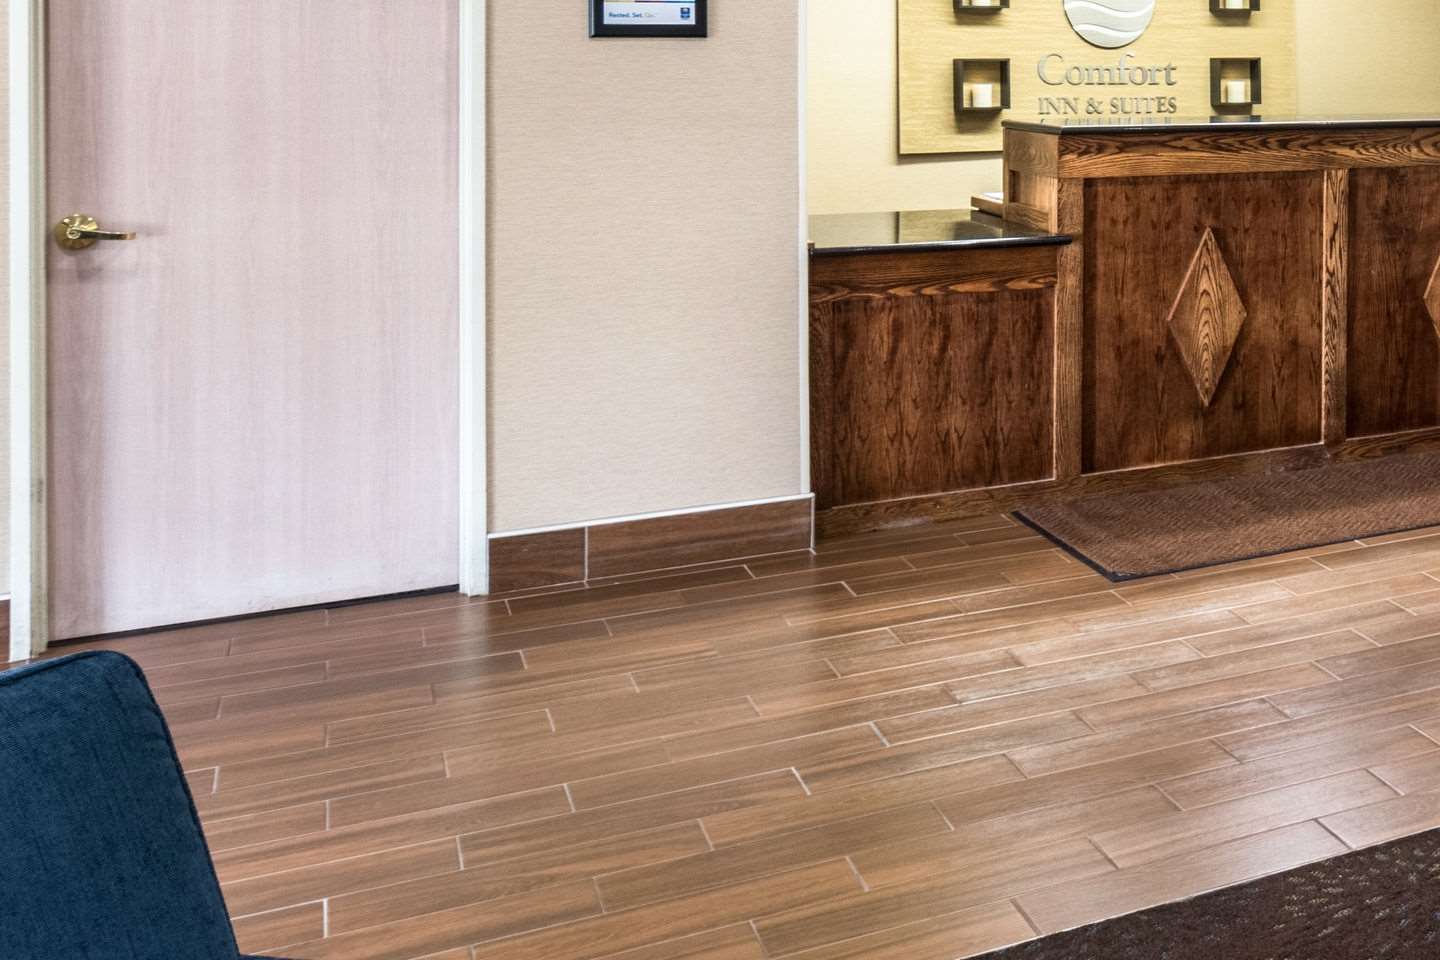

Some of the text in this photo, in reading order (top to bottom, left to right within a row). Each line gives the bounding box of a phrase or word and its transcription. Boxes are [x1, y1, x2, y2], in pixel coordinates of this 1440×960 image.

[1037, 53, 1177, 86] Comfort
[1037, 96, 1177, 115] INN & SUITES
